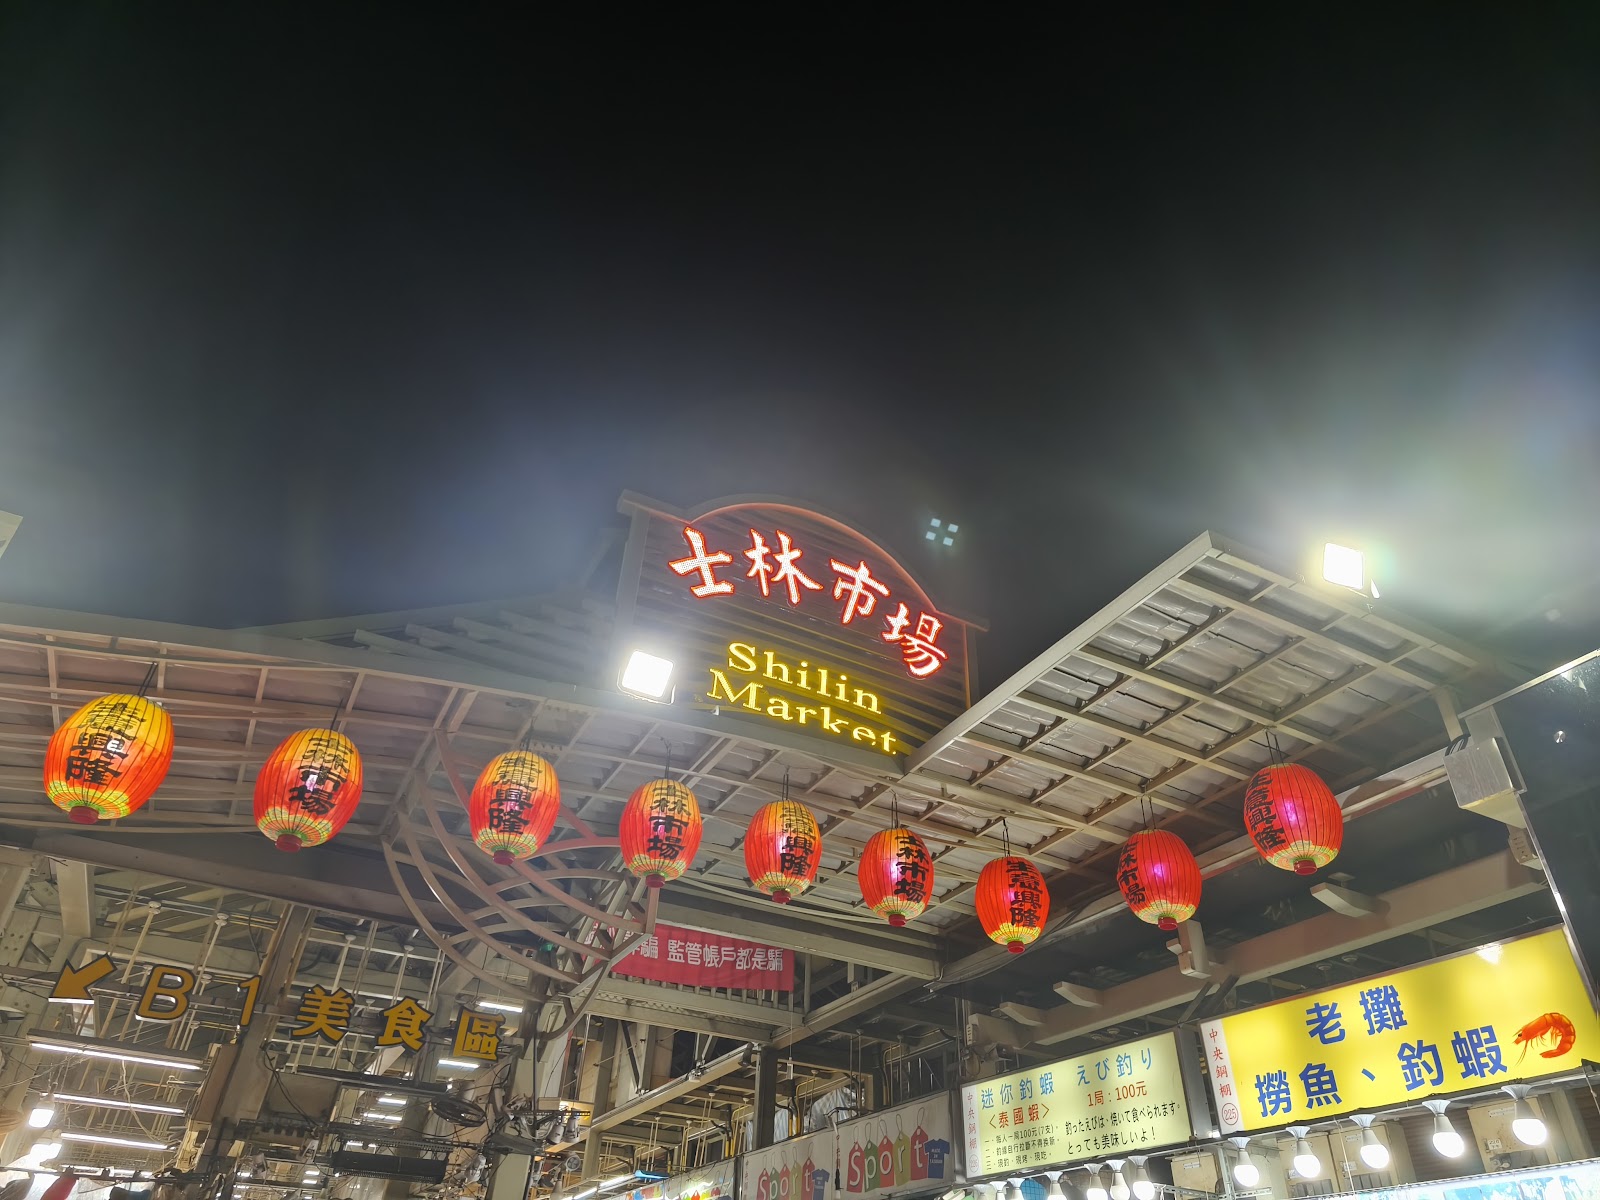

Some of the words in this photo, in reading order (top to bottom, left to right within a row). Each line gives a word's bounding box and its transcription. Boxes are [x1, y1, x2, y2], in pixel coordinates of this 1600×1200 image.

[668, 526, 948, 677] 士林市場
[728, 641, 882, 715] Shilin
[706, 667, 897, 756] Market
[289, 737, 354, 815] 士林市場
[647, 785, 692, 860] 士林市場
[894, 835, 930, 903] 士林市場
[667, 939, 784, 971] 監管帳戶都是騙
[1305, 984, 1408, 1045] 老攤
[981, 1072, 1055, 1110] 迷你釣蝦
[1076, 1047, 1153, 1087] えび釣り
[1223, 1107, 1237, 1121] 225
[759, 1169, 811, 1200] Sport
[850, 1139, 923, 1187] Sport
